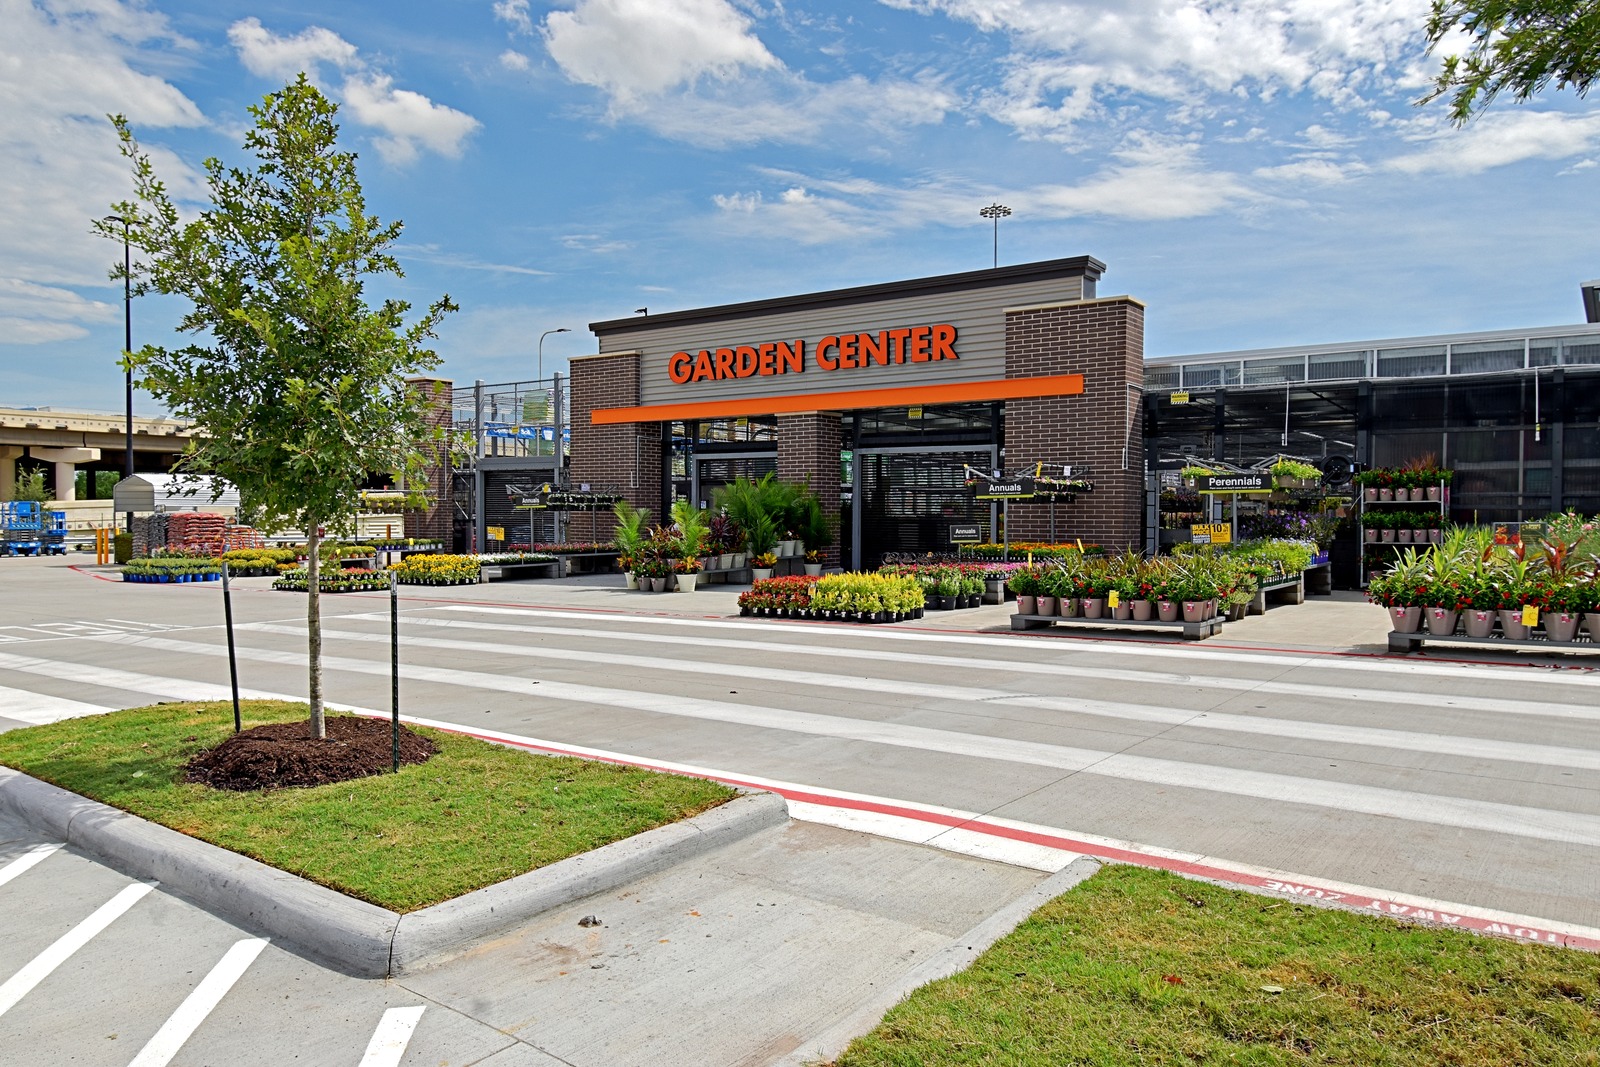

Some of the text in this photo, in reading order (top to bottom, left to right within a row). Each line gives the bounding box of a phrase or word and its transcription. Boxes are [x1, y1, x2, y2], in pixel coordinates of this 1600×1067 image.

[668, 324, 959, 384] GARDEN CENTER
[989, 484, 1022, 492] Annuals
[1209, 476, 1262, 486] Perennials
[1212, 524, 1222, 533] 10
[1260, 880, 1345, 900] ZONE
[1366, 901, 1460, 923] AWAY
